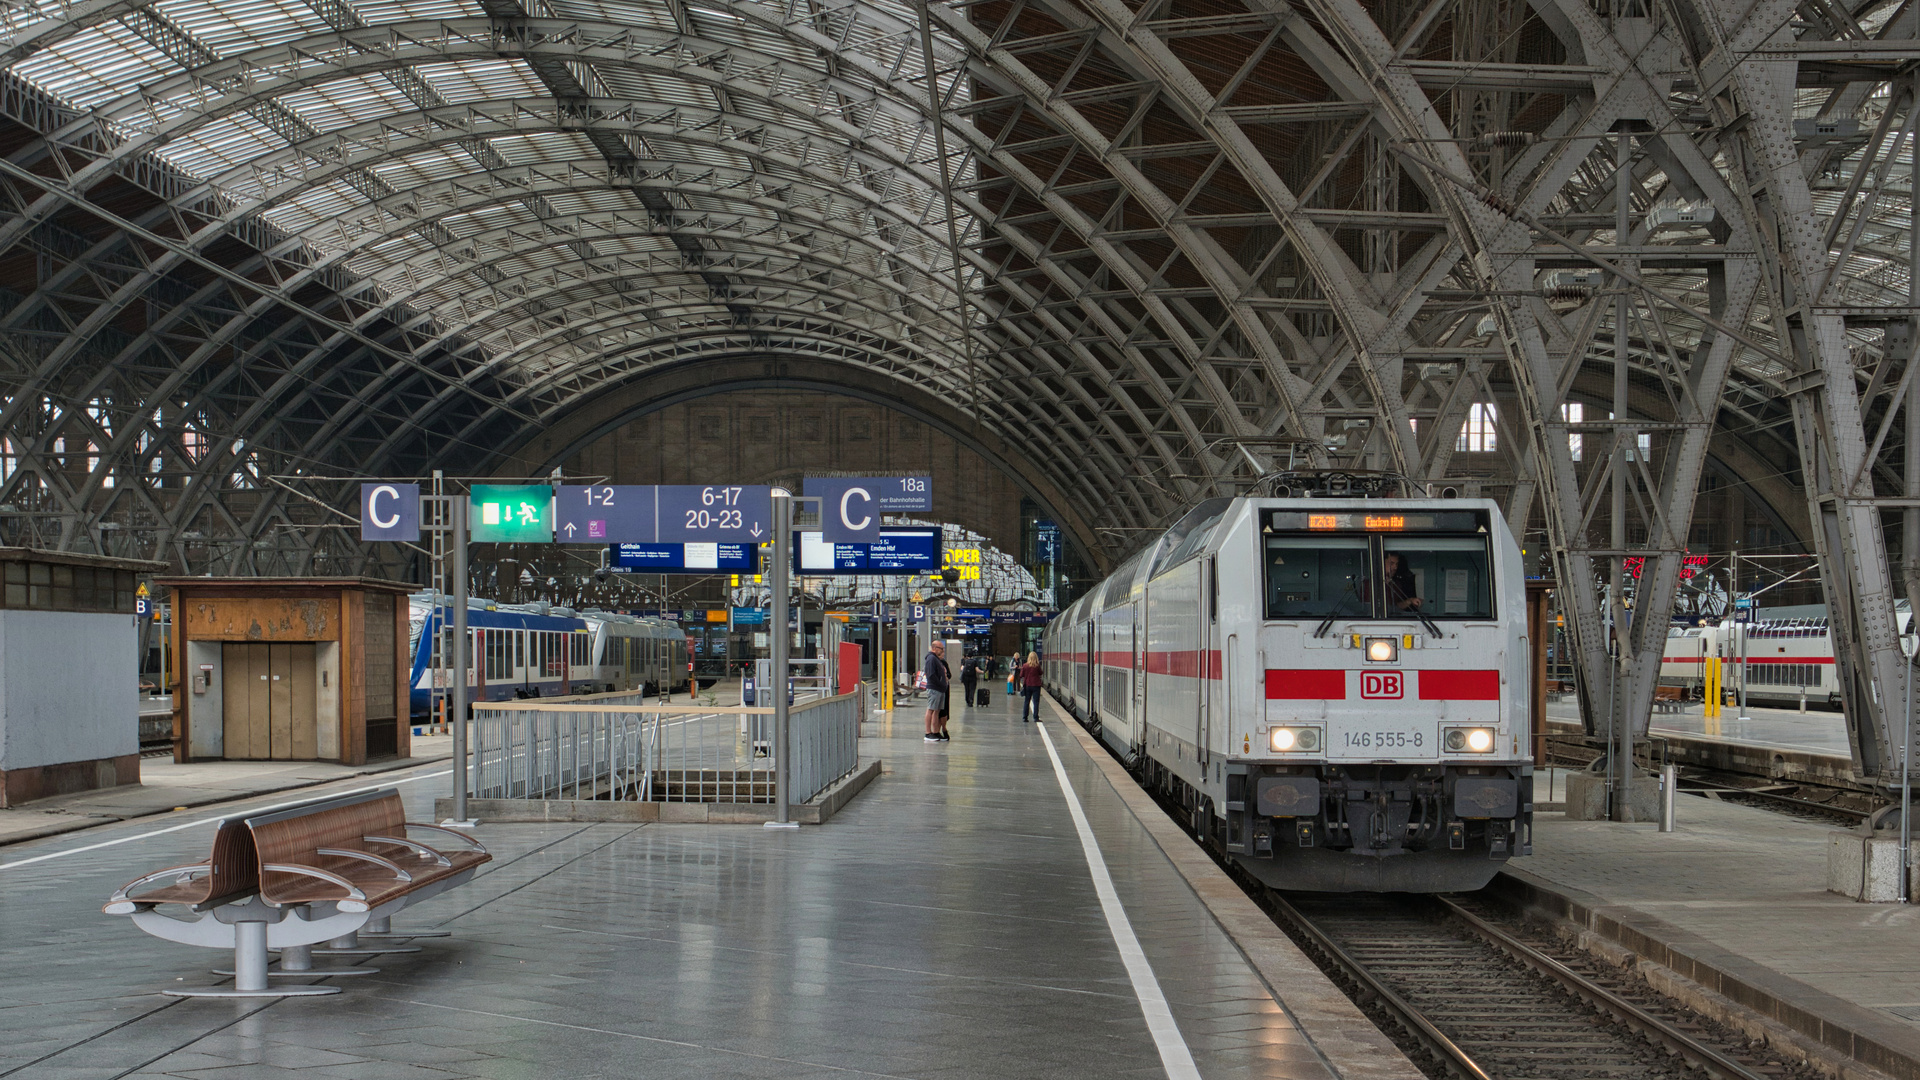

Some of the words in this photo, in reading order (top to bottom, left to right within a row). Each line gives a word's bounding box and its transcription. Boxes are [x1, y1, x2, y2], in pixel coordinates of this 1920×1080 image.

[900, 478, 925, 492] 18a
[584, 487, 615, 506] 1-2
[702, 487, 743, 506] 6-17
[368, 485, 401, 529] C
[840, 487, 872, 531] C
[685, 509, 743, 529] 20-23
[1365, 516, 1389, 528] Emden
[1390, 516, 1404, 528] Hbf
[945, 549, 980, 563] OPER
[136, 600, 146, 614] B
[914, 605, 924, 619] B
[1364, 674, 1400, 696] DB
[1344, 731, 1371, 748] 146
[1375, 731, 1424, 748] 555-8
